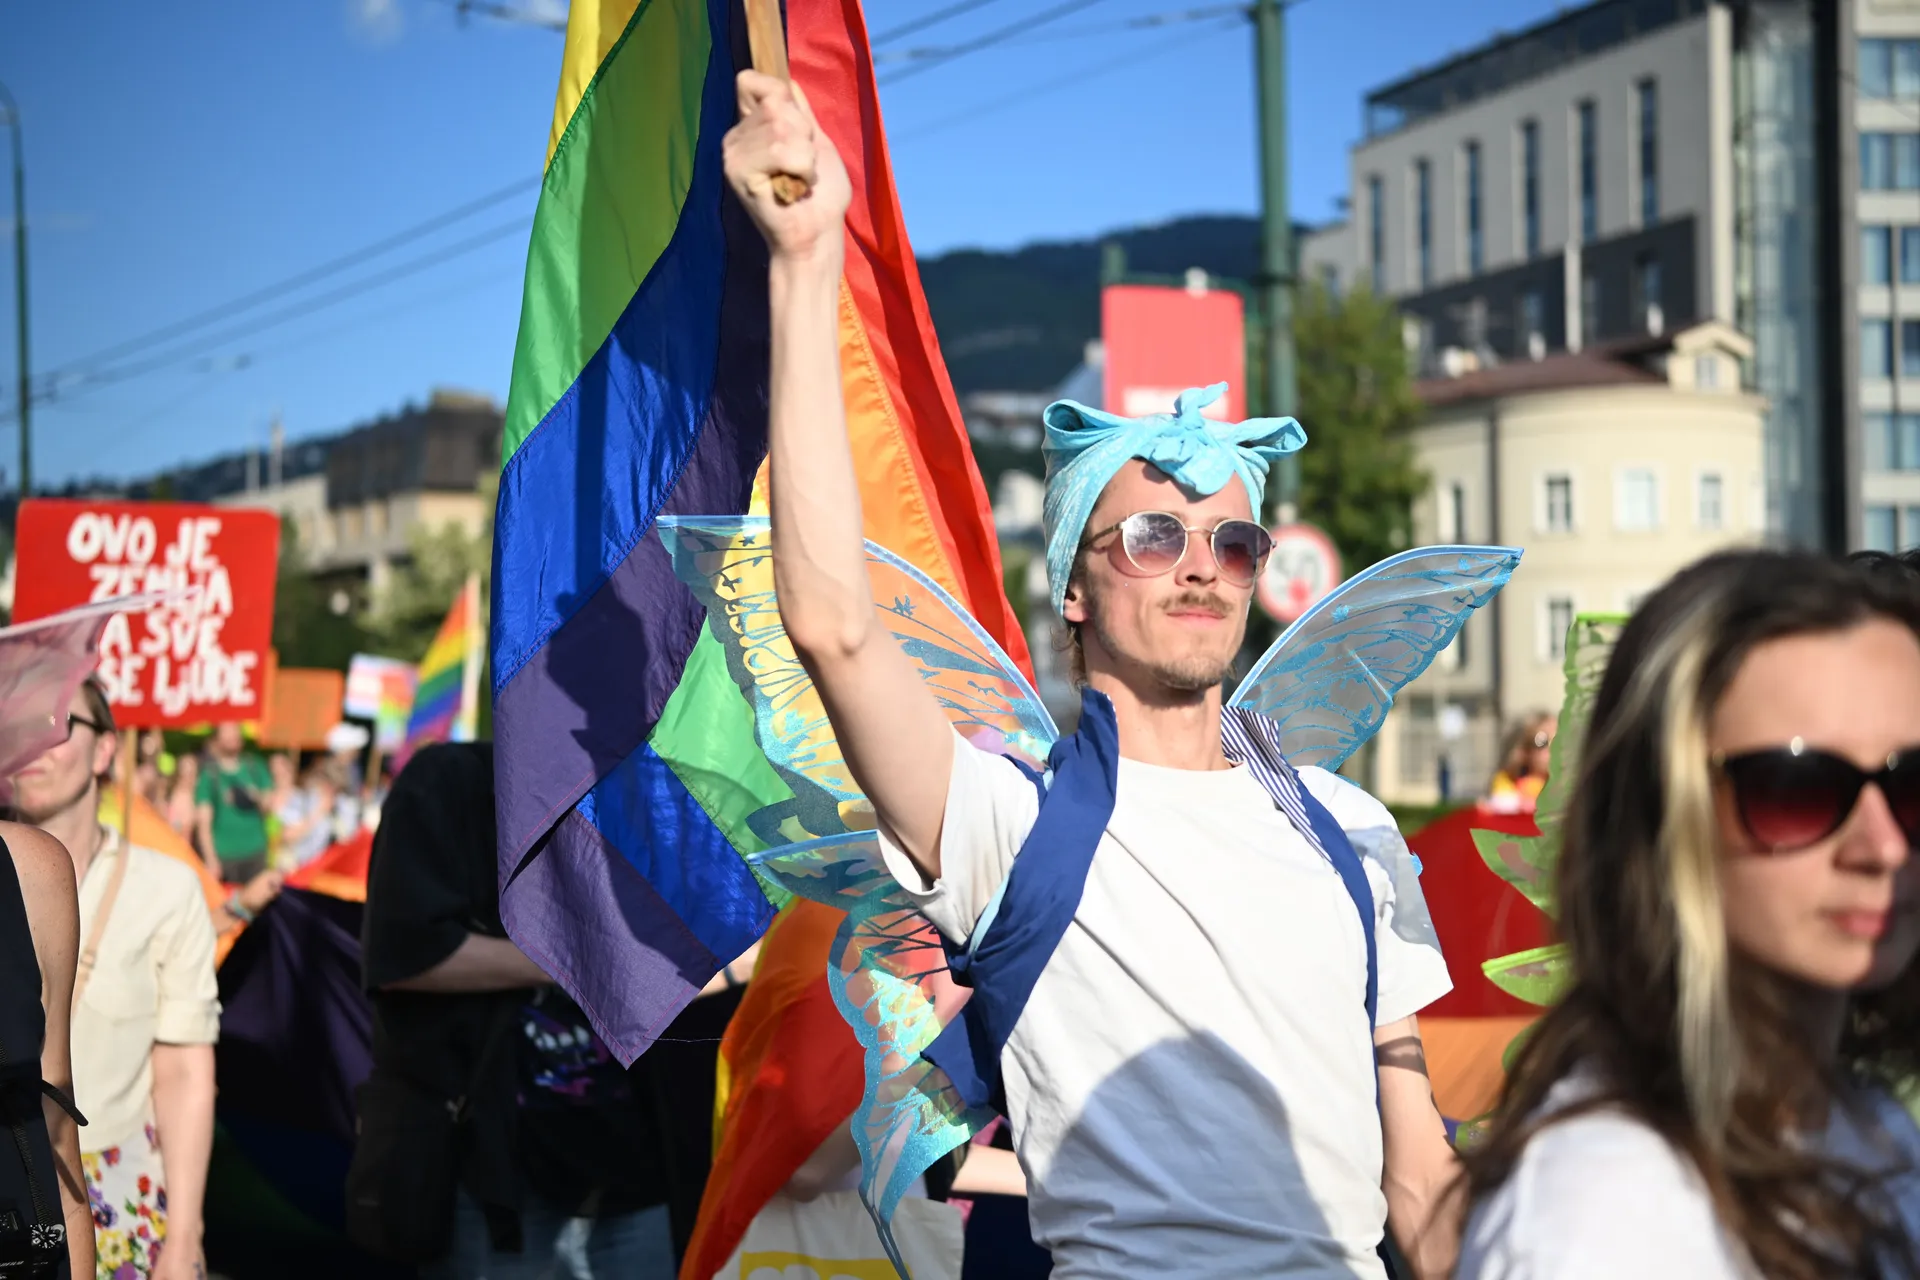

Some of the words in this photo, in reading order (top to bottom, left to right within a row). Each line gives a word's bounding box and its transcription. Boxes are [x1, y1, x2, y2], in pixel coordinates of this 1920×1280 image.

[67, 513, 157, 563] OVO
[165, 517, 221, 570] JE
[139, 611, 225, 660] SVE
